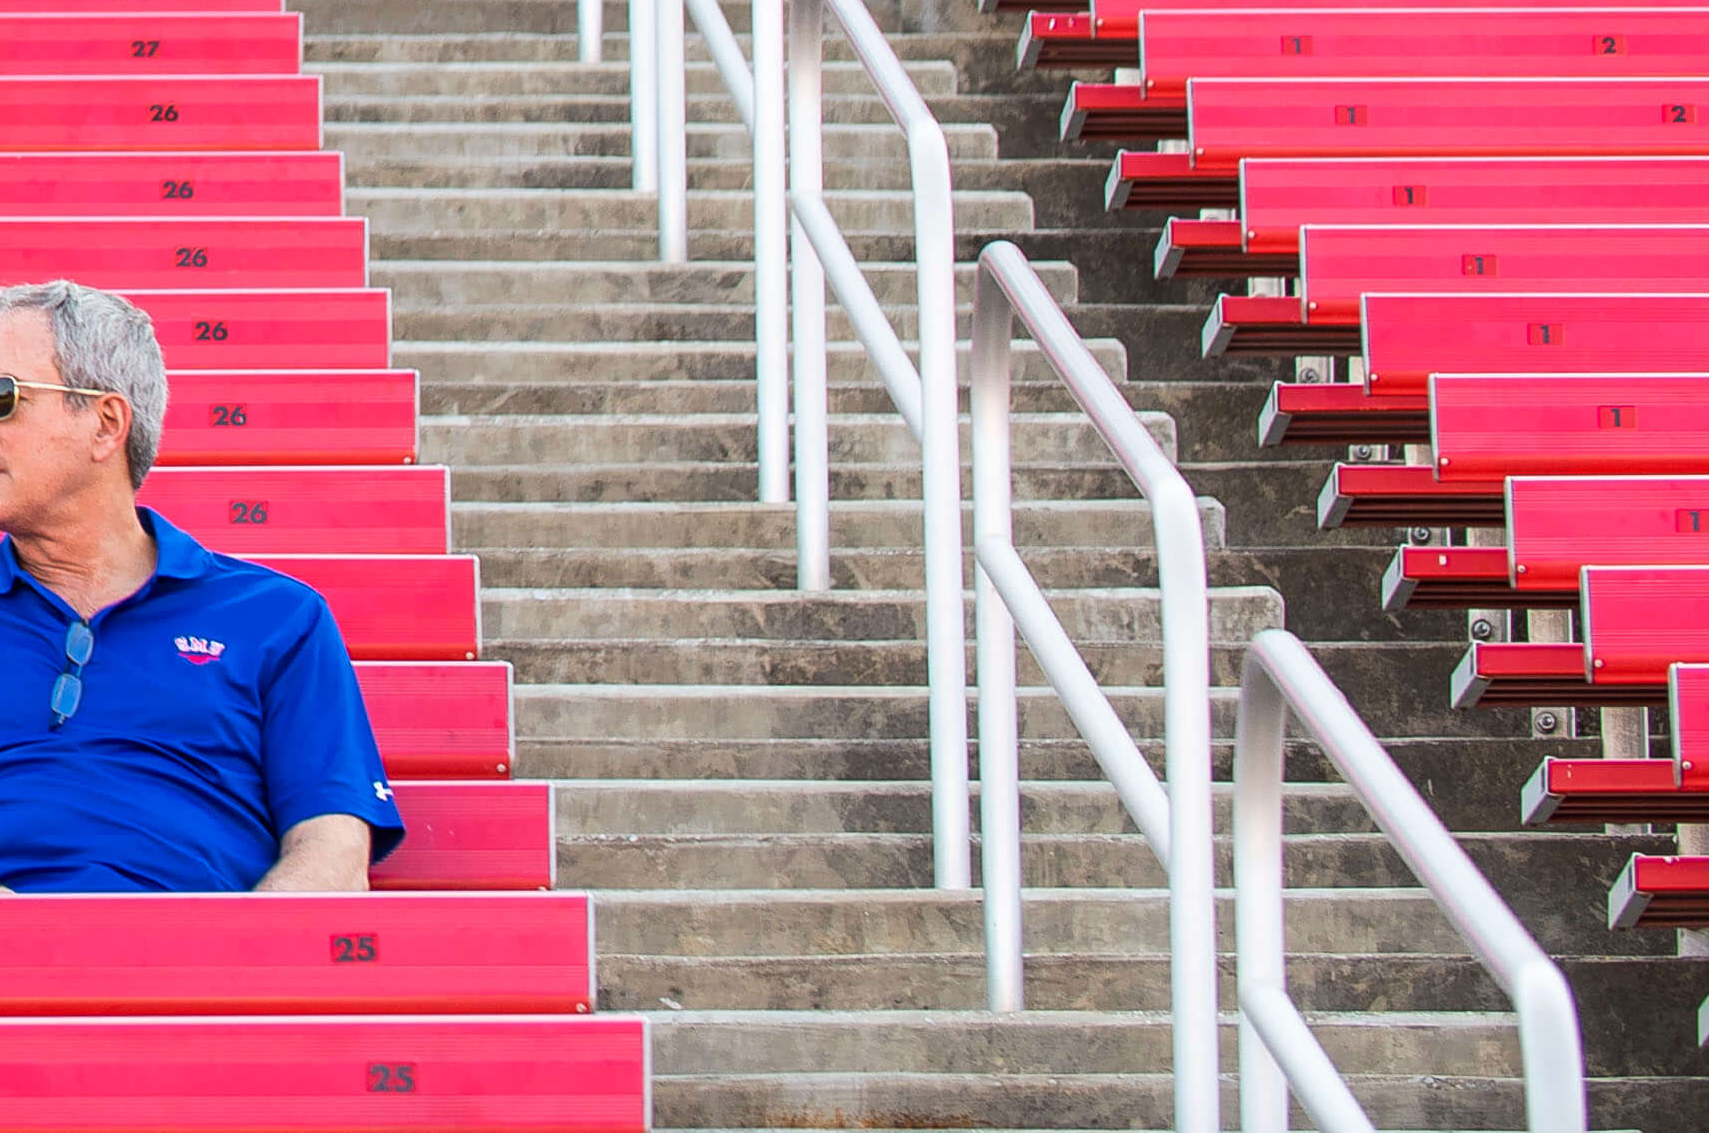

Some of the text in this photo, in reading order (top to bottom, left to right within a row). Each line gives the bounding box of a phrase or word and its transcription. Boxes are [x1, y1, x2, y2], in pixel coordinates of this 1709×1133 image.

[132, 41, 159, 57] 27
[1602, 37, 1616, 54] 2
[150, 105, 178, 122] 26
[1671, 105, 1686, 123] 2
[164, 181, 193, 199] 26
[176, 248, 207, 267] 26
[1473, 256, 1485, 276] 1
[196, 321, 228, 341] 26
[1539, 324, 1551, 345] 1
[213, 406, 247, 426] 26
[1610, 407, 1622, 428] 1
[233, 502, 267, 524] 26
[1688, 510, 1700, 532] 1
[335, 937, 376, 962] 25
[371, 1065, 414, 1093] 25
